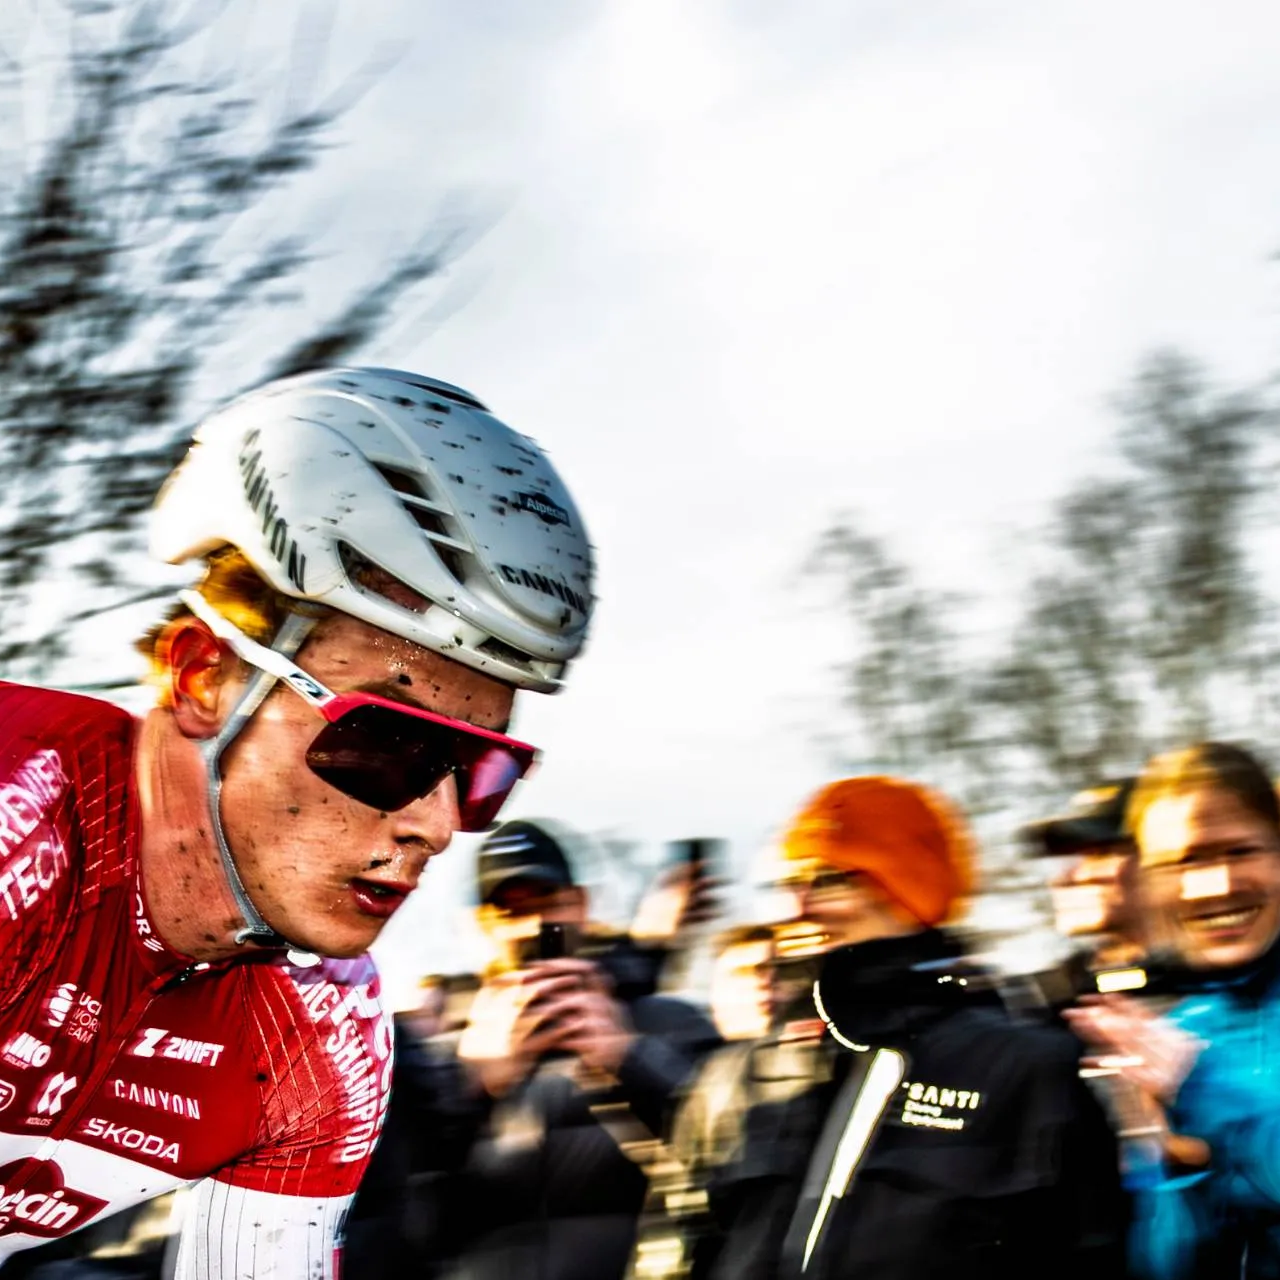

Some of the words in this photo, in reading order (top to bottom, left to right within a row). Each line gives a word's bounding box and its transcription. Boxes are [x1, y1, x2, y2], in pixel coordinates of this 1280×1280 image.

[78, 992, 103, 1016] UCI
[163, 1037, 225, 1067] ZWIFT
[114, 1079, 201, 1121] CANYON
[325, 1018, 380, 1164] SHAMPOO
[907, 1082, 981, 1110] SANTI
